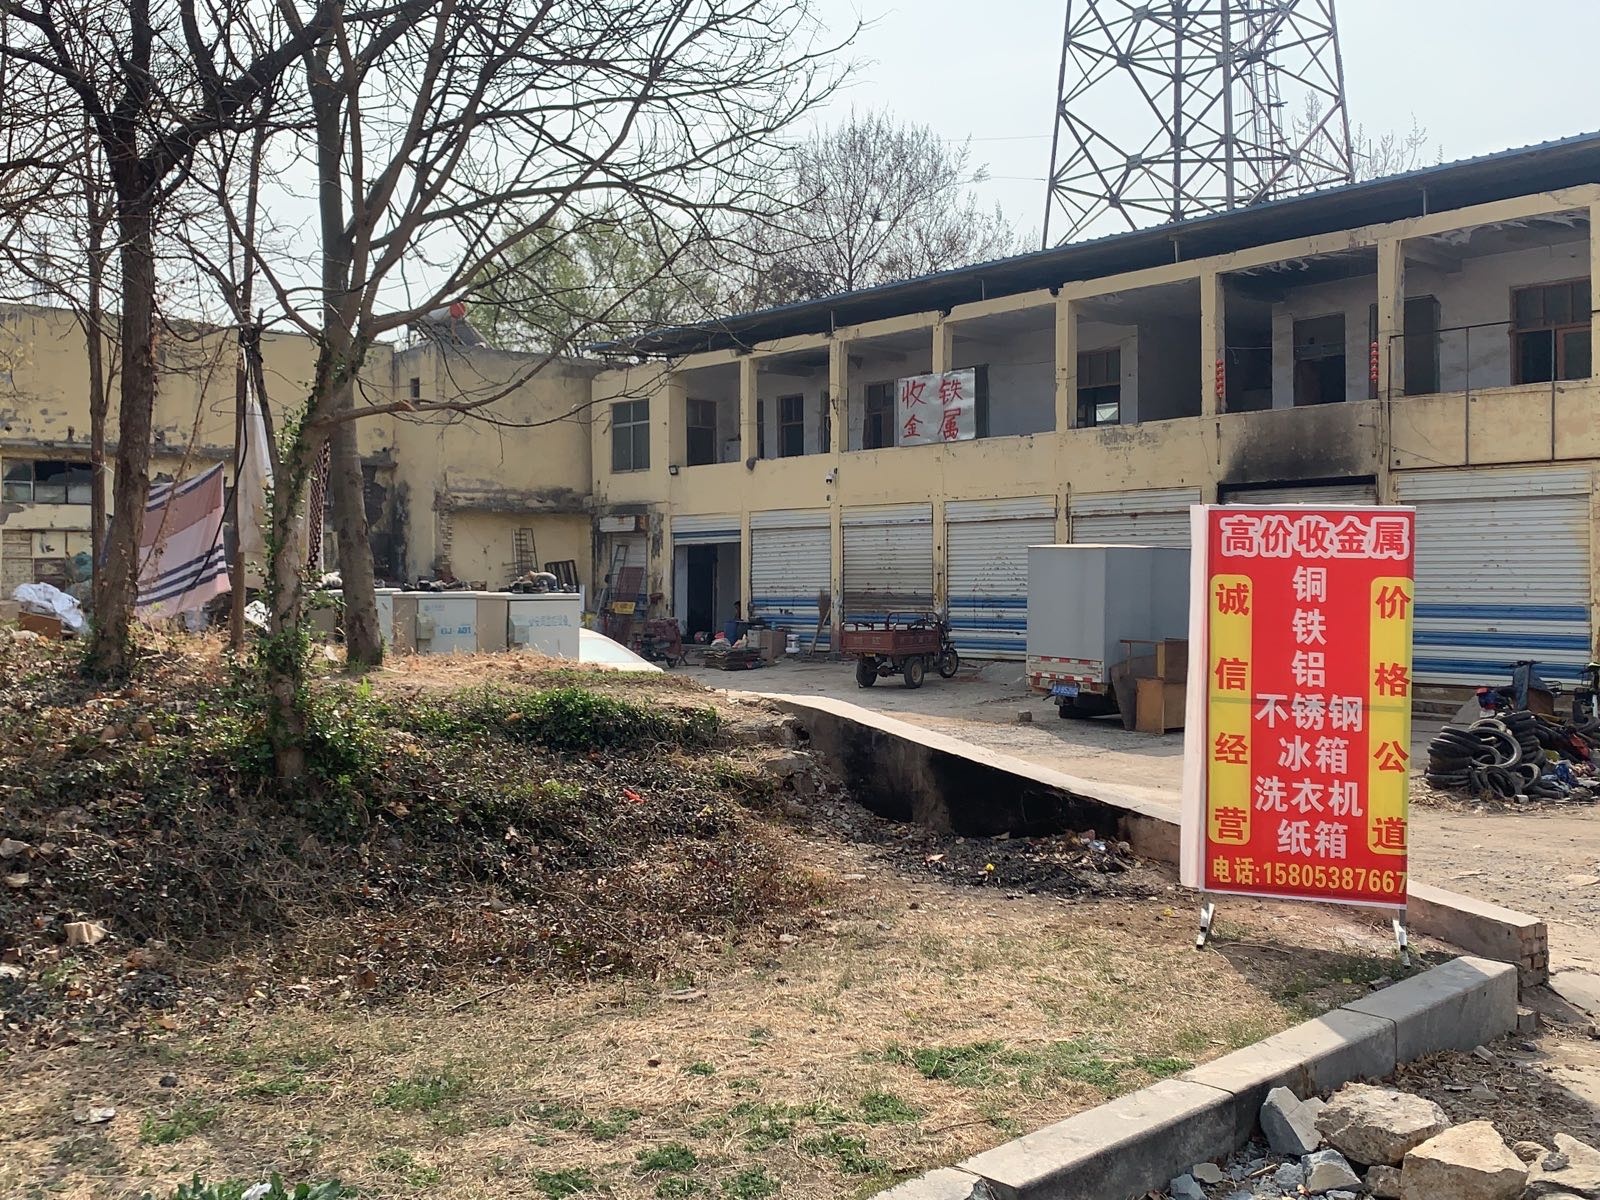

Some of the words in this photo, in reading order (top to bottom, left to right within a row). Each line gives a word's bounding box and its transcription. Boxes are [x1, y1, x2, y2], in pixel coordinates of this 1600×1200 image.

[902, 379, 964, 409] 收铁
[903, 408, 962, 440] 金属
[1220, 515, 1409, 560] 高价收金属
[1292, 566, 1327, 602] 铜
[1292, 608, 1327, 645] 铁
[1291, 650, 1326, 688] 铝
[1215, 583, 1250, 840] 诚信经营
[1255, 693, 1363, 732] 不锈钢
[1372, 586, 1411, 850] 价格公道
[1278, 735, 1349, 774] 冰箱
[1254, 776, 1363, 817] 洗衣机
[1277, 819, 1348, 859] 纸箱
